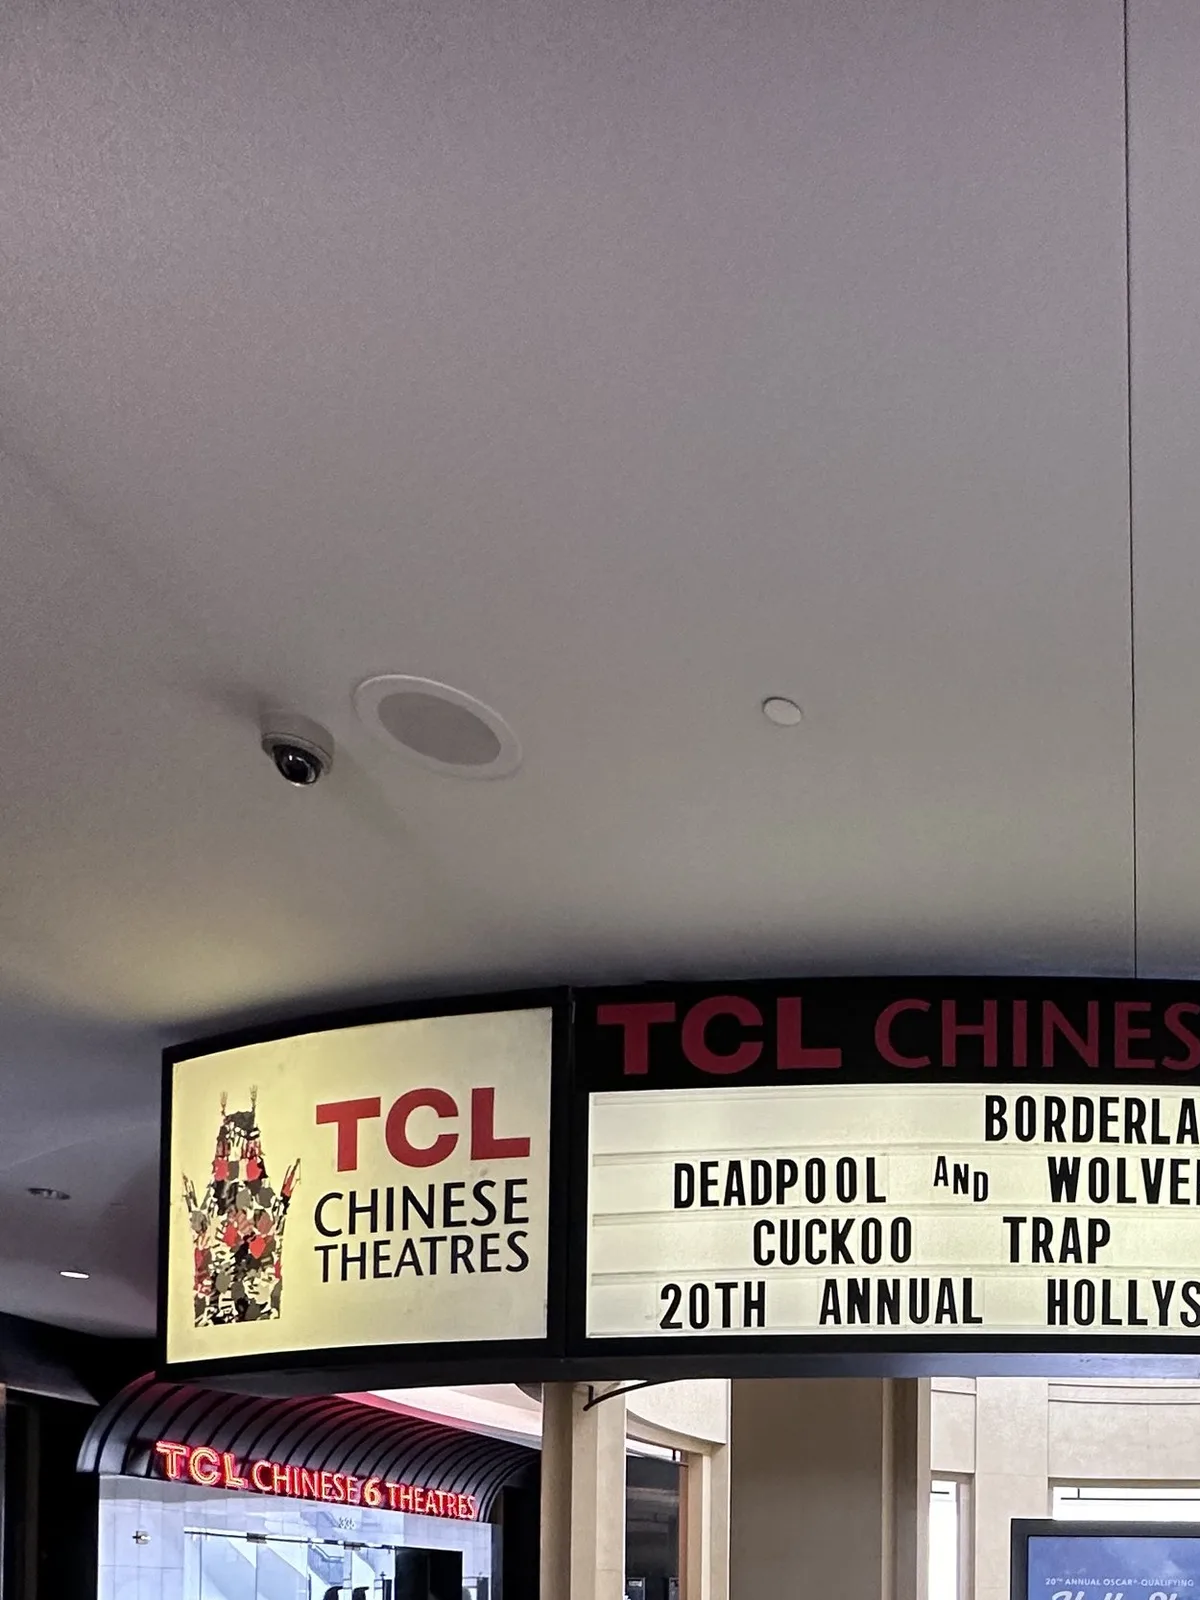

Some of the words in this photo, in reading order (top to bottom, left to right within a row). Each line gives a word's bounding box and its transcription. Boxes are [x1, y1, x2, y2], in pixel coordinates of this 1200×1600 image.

[597, 995, 841, 1075] TCL
[315, 1086, 532, 1173] TCL
[314, 1178, 530, 1238] CHINESE
[673, 1156, 887, 1209] DEADPOOL
[933, 1155, 989, 1202] AND
[314, 1230, 530, 1283] THEATRES
[753, 1216, 912, 1267] CUCKOO
[1002, 1216, 1111, 1264] TRAP
[659, 1280, 766, 1330] 20TH
[818, 1277, 983, 1326] ANNUAL
[156, 1441, 248, 1489] TCL
[251, 1460, 360, 1502] CHINESE
[363, 1477, 381, 1506] 6
[385, 1482, 478, 1520] THEATRES
[1065, 1578, 1100, 1586] ANNUAL
